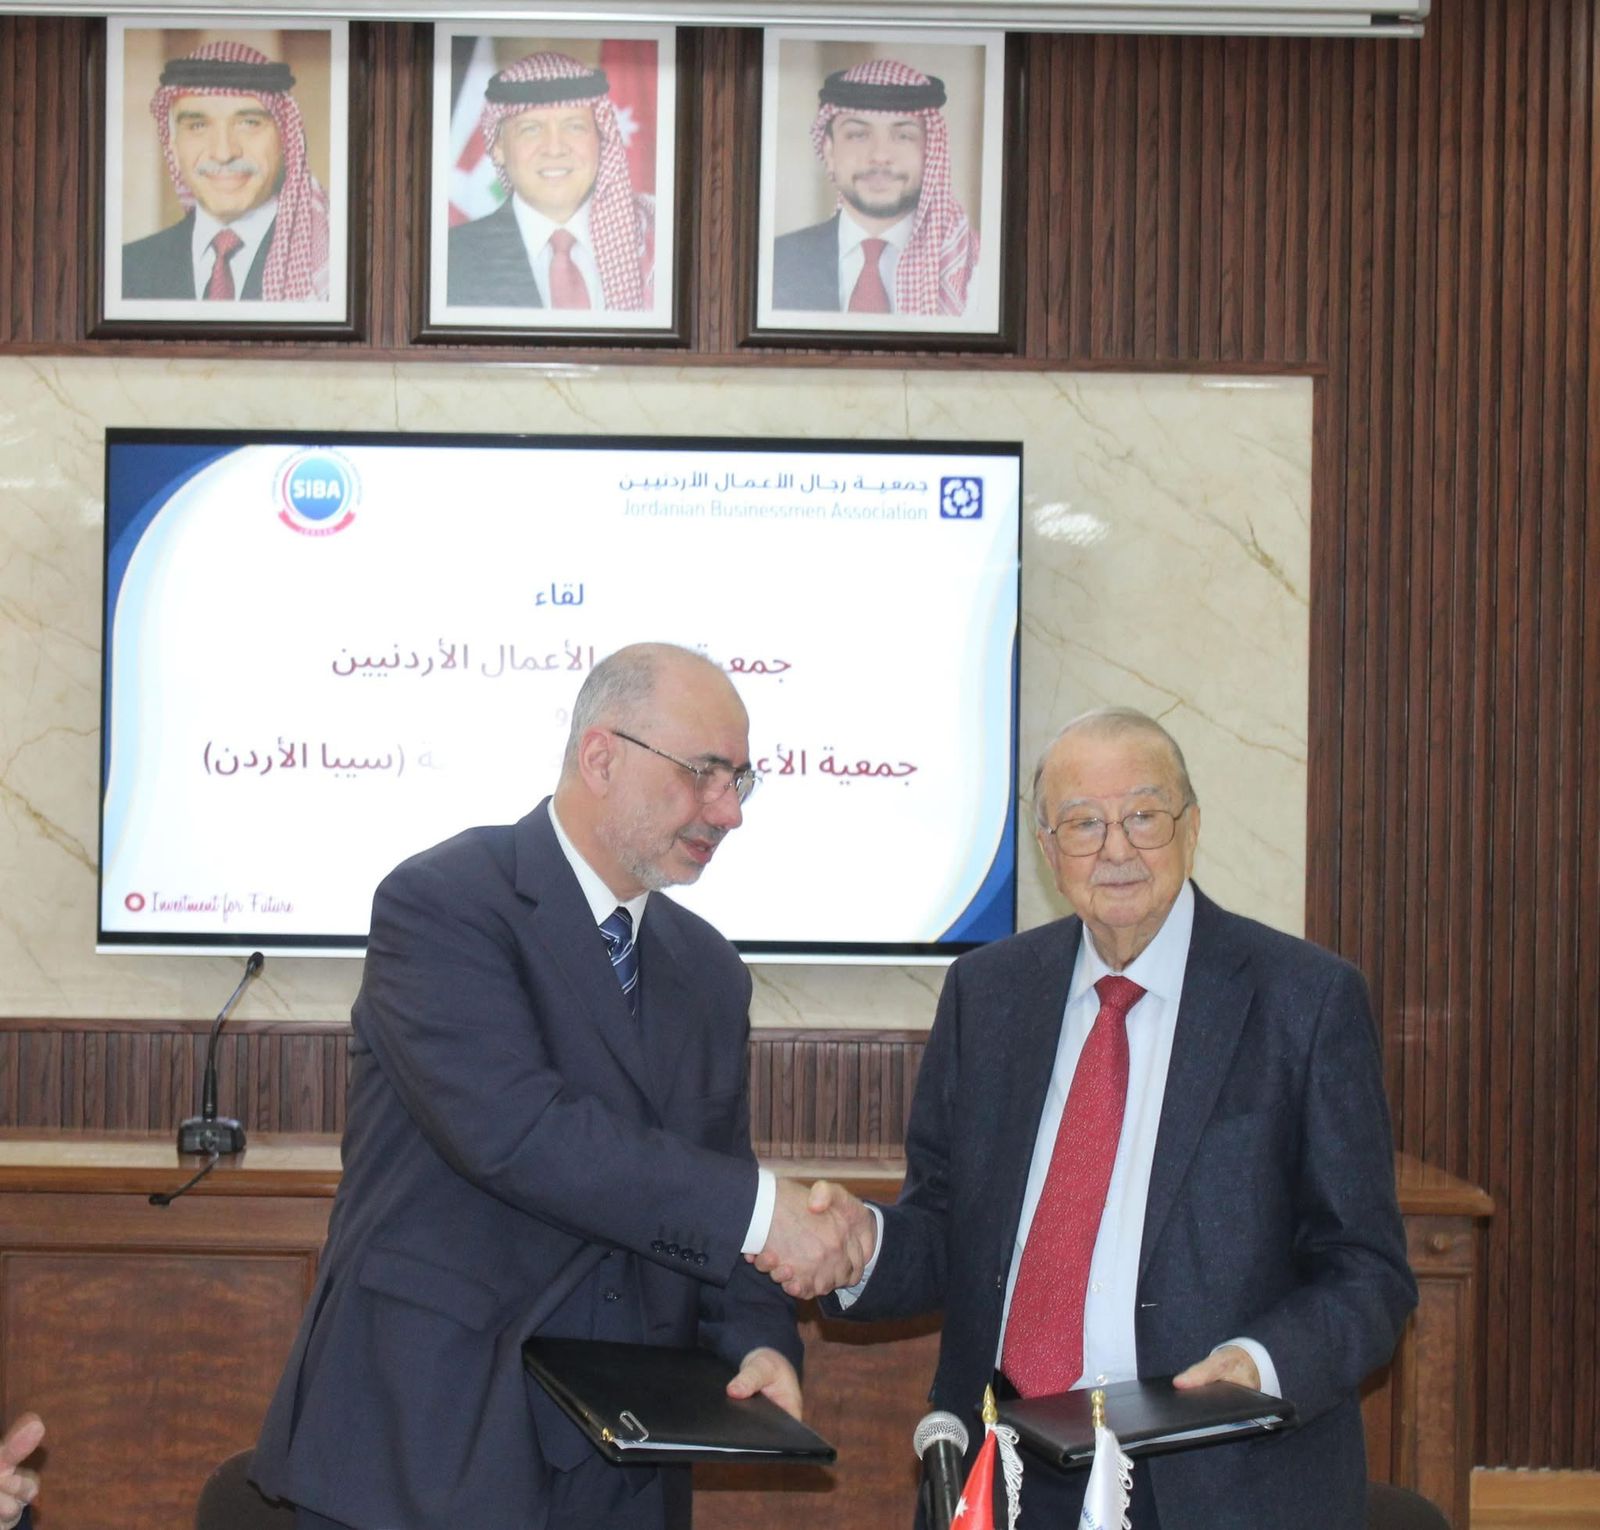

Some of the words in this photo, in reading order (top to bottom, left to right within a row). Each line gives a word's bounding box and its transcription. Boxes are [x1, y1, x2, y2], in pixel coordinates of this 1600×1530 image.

[293, 479, 341, 500] SIBA
[619, 470, 709, 491] الأردنيين
[714, 471, 794, 493] الأعمال
[800, 473, 847, 494] رجال
[853, 474, 929, 495] جمعية
[624, 499, 705, 517] Jordanian
[710, 500, 826, 519] Businessmen
[830, 501, 928, 521] Association
[534, 582, 585, 606] لقاء
[331, 637, 469, 677] الأردنيين
[202, 736, 309, 777] الأردن)
[319, 741, 405, 779] (سيبا
[818, 745, 919, 786] جمعية
[151, 891, 219, 913] Investment
[222, 892, 243, 923] for
[248, 892, 294, 913] Future
